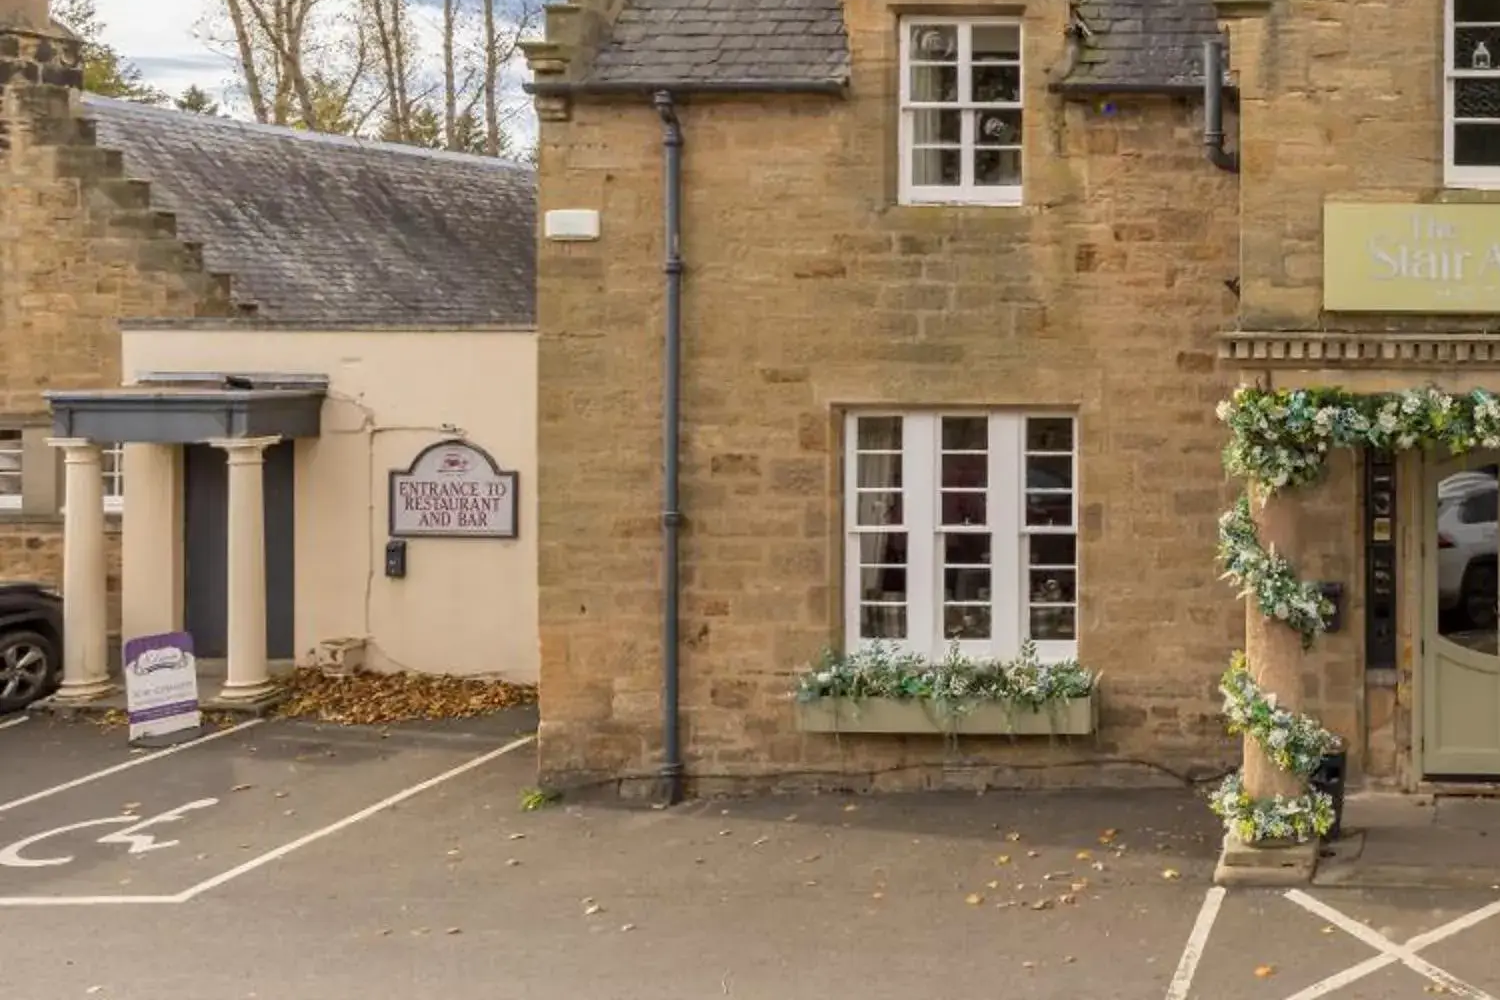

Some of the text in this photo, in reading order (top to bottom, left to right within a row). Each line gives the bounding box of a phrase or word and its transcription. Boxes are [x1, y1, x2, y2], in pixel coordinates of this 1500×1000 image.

[1366, 230, 1472, 282] Stair
[399, 481, 507, 497] ENTRANCE TO
[404, 496, 501, 512] RESTAURANT
[418, 511, 489, 527] AND BAR
